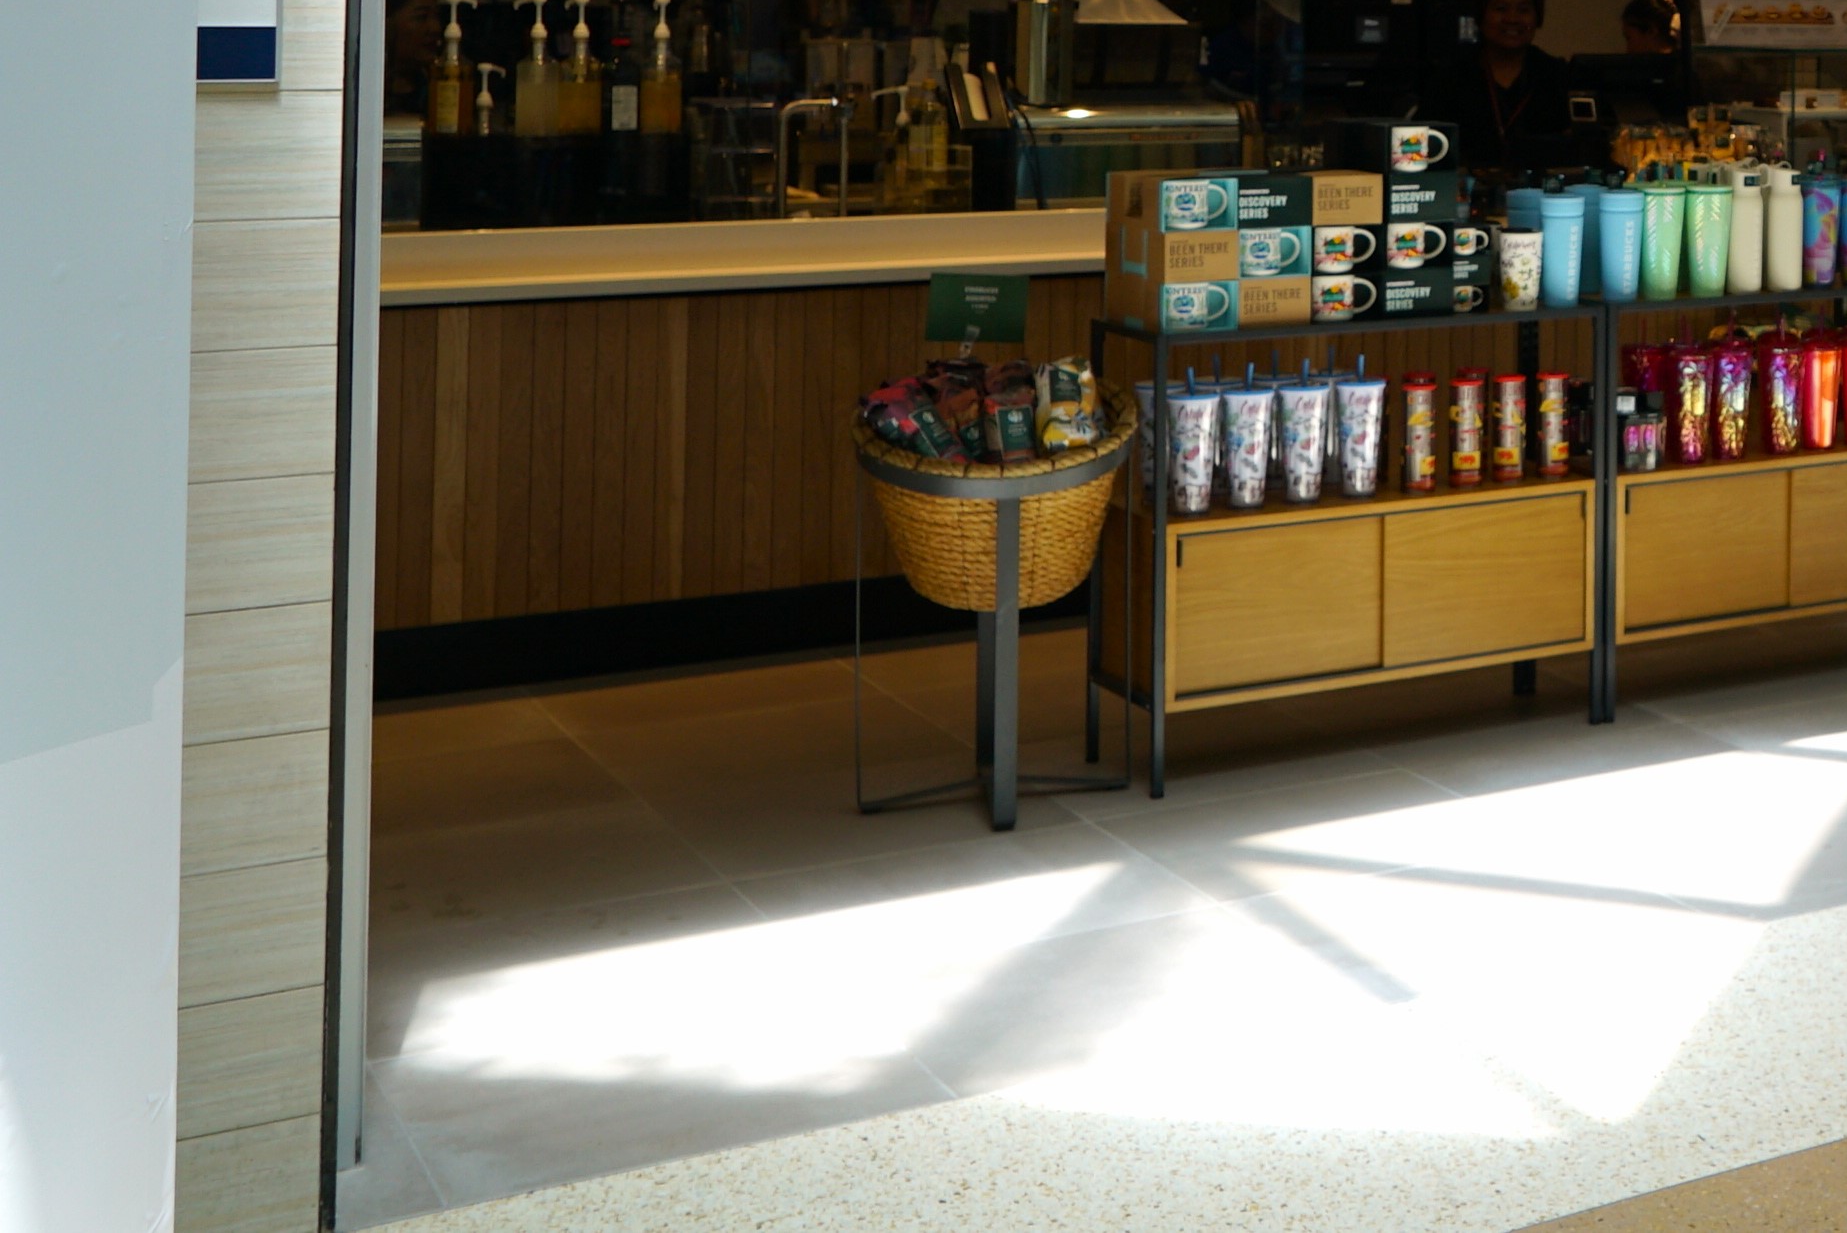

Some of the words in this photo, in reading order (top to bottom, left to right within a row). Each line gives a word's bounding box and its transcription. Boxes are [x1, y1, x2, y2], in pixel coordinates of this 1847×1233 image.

[1239, 195, 1288, 208] DISCOVERY
[1239, 207, 1269, 220] SERIES
[1169, 243, 1195, 256] BEEN
[1199, 241, 1230, 254] THERE
[1169, 255, 1205, 269] SERIES
[1243, 289, 1270, 303] BEEN
[1272, 287, 1302, 301] THERE
[1243, 301, 1278, 315] SERIES
